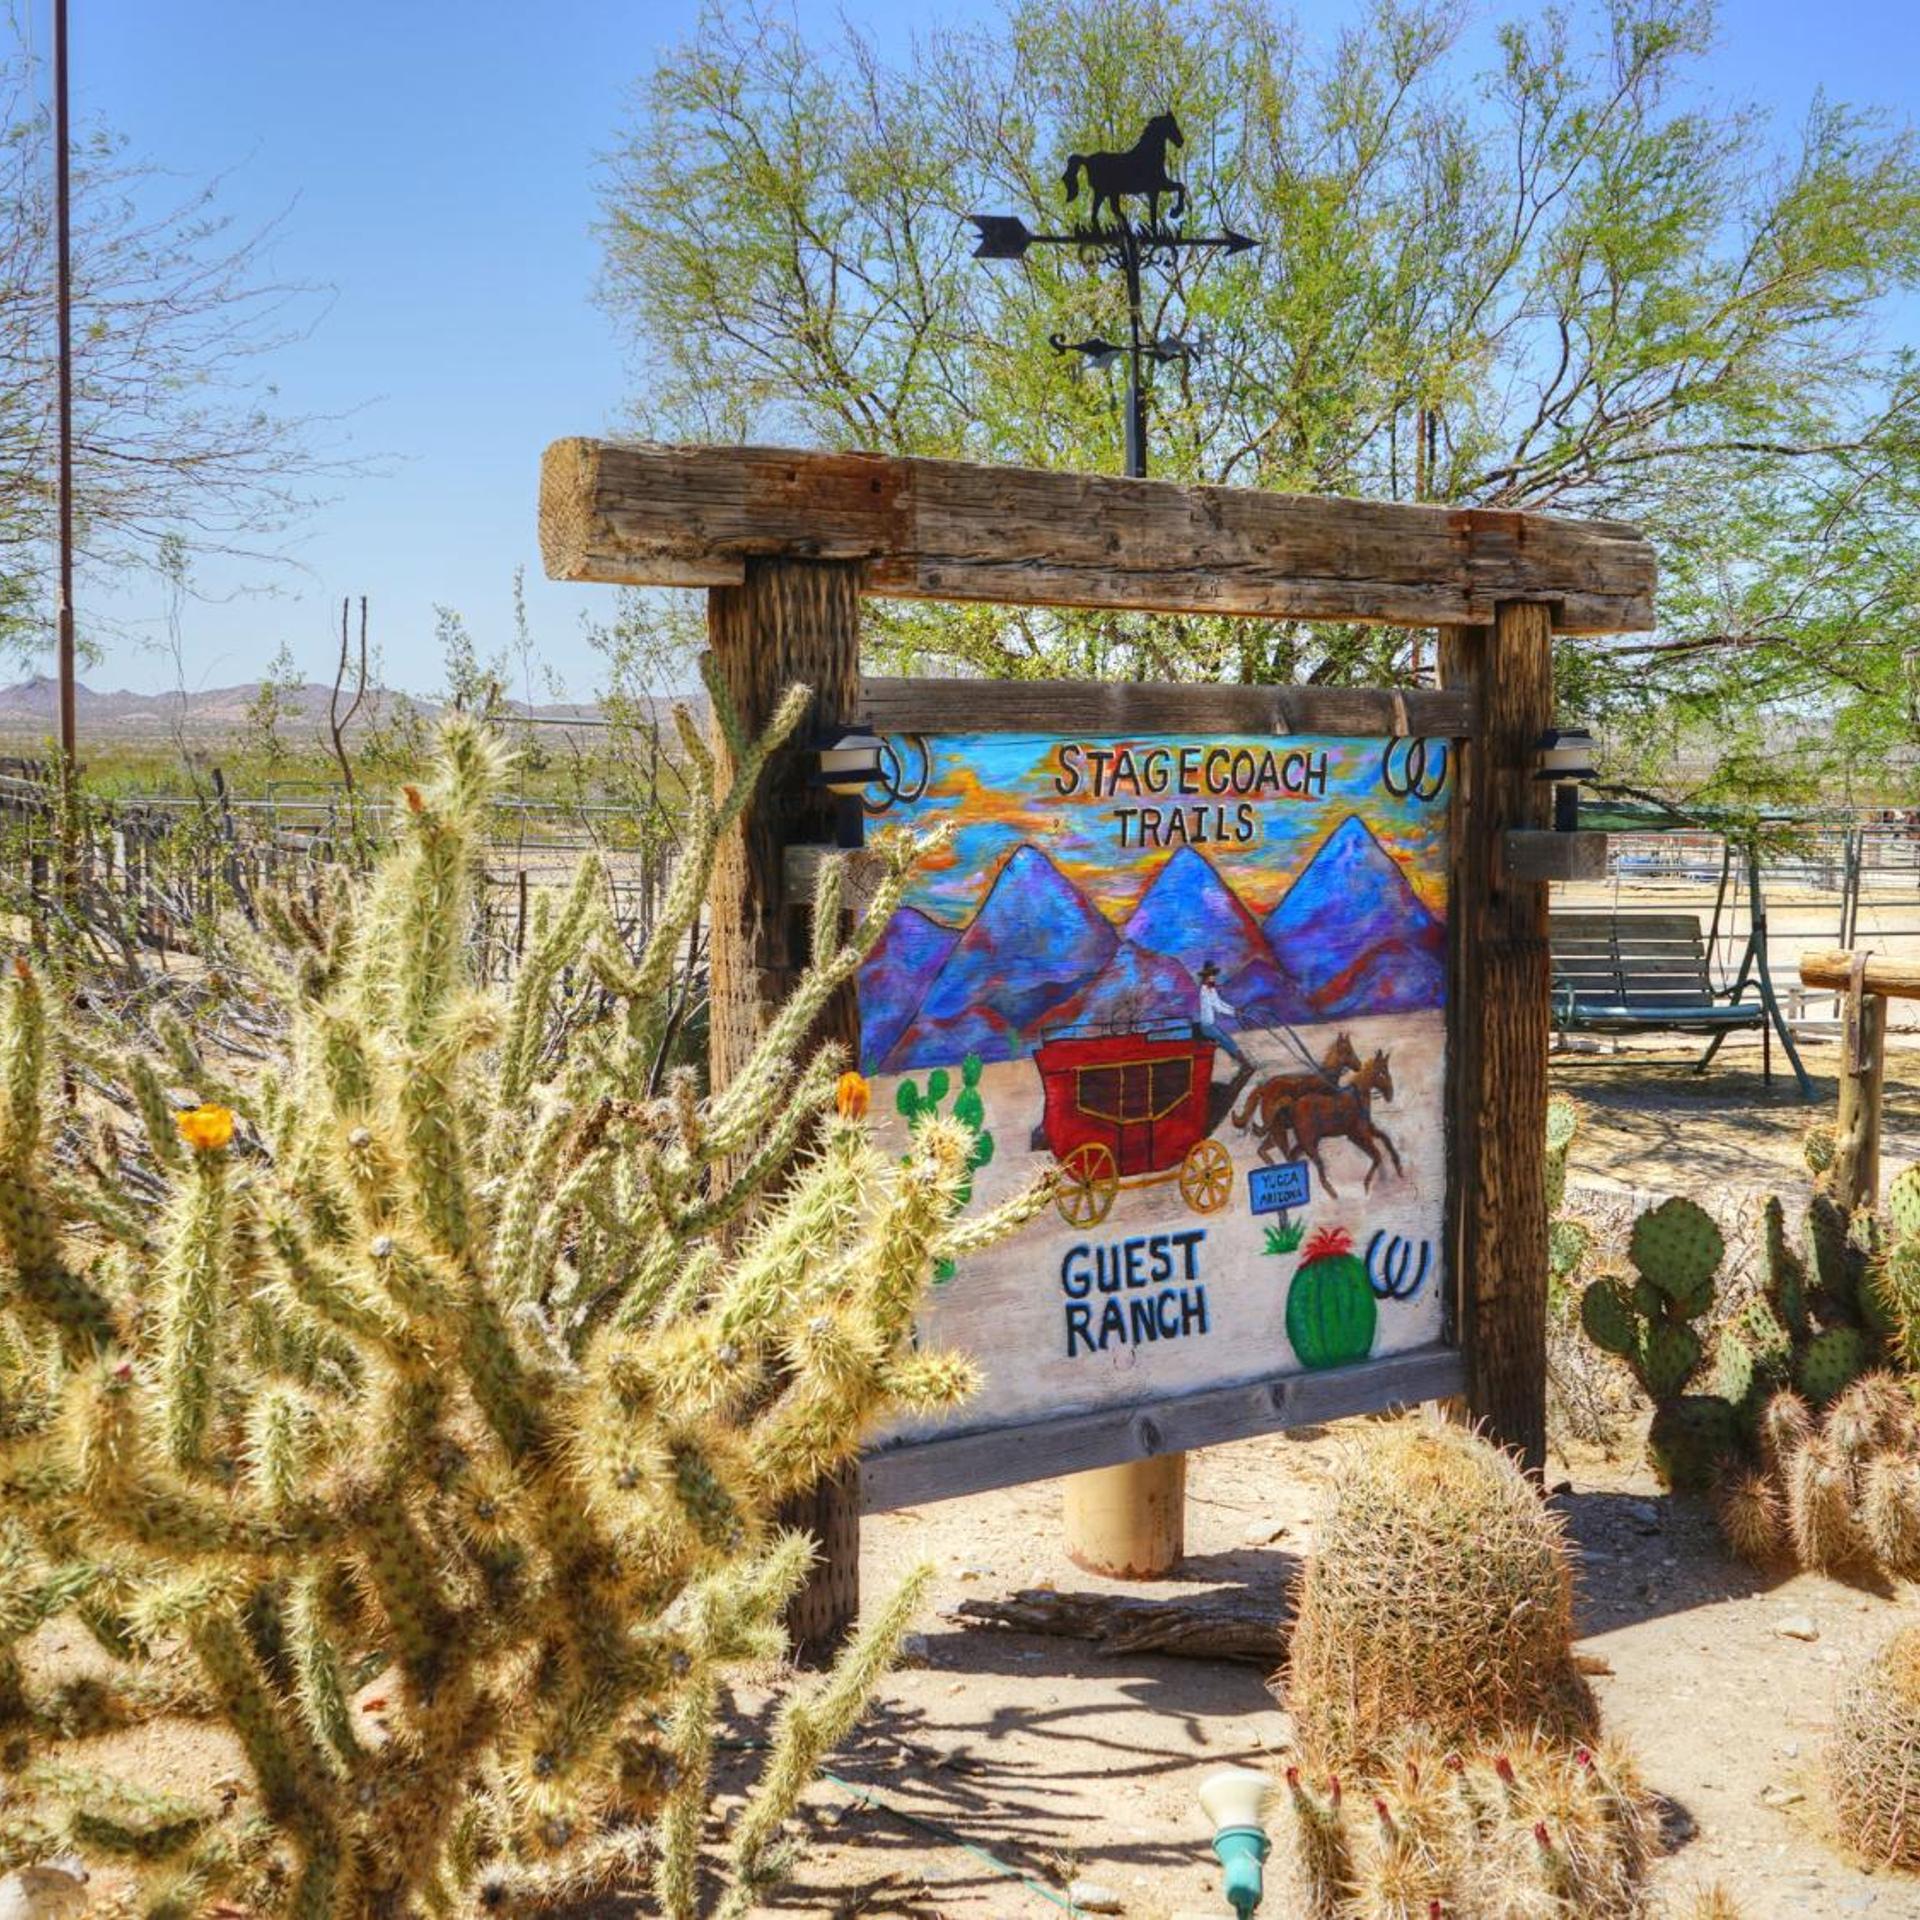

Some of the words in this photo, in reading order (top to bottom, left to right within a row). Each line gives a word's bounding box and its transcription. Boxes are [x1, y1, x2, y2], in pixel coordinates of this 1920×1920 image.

[1055, 744, 1328, 797] STAGECOACH
[1113, 803, 1255, 848] TRAILS
[1061, 1228, 1206, 1299] GUEST
[1065, 1285, 1207, 1358] RANCH
